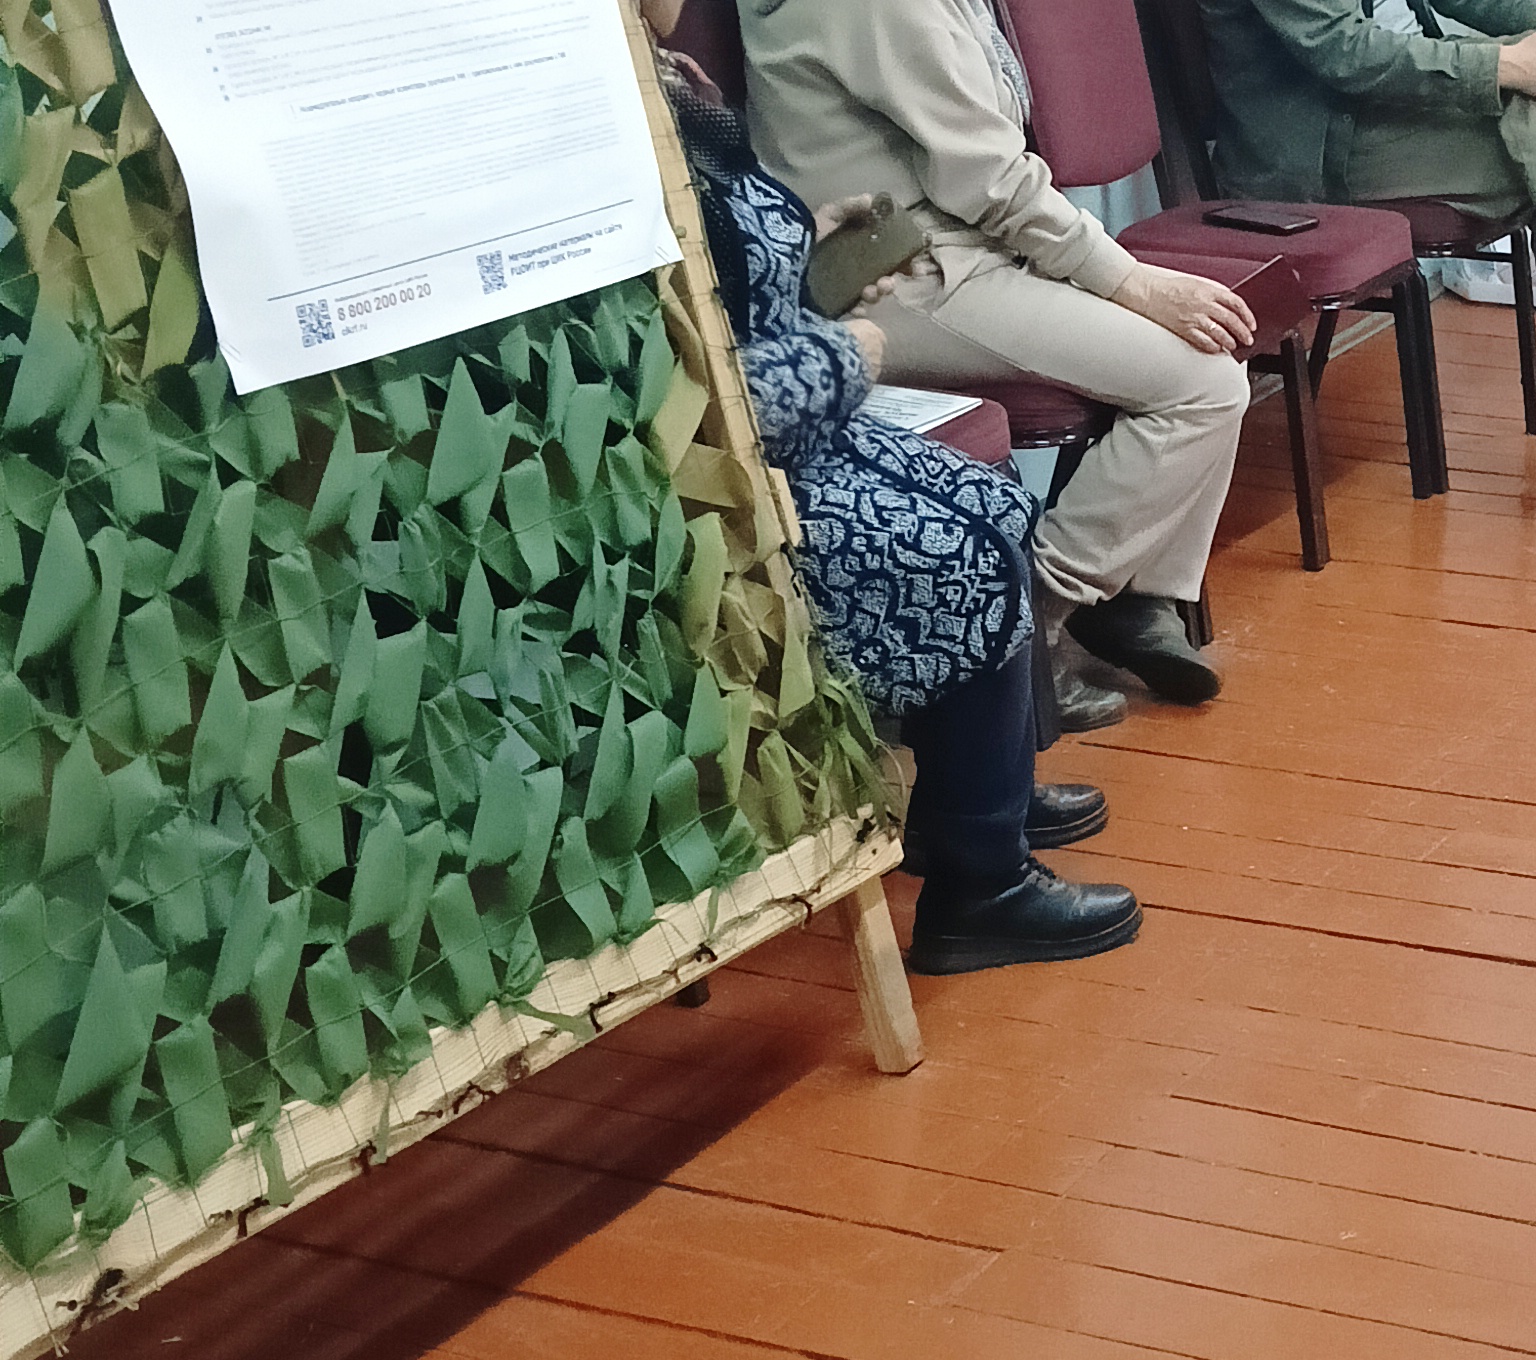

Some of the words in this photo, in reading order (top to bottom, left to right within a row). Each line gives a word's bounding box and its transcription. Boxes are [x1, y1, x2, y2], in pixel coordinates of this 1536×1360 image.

[337, 307, 346, 321] 8
[348, 300, 372, 318] 800
[374, 293, 397, 310] 200
[400, 287, 414, 303] 00
[416, 282, 431, 298] 20
